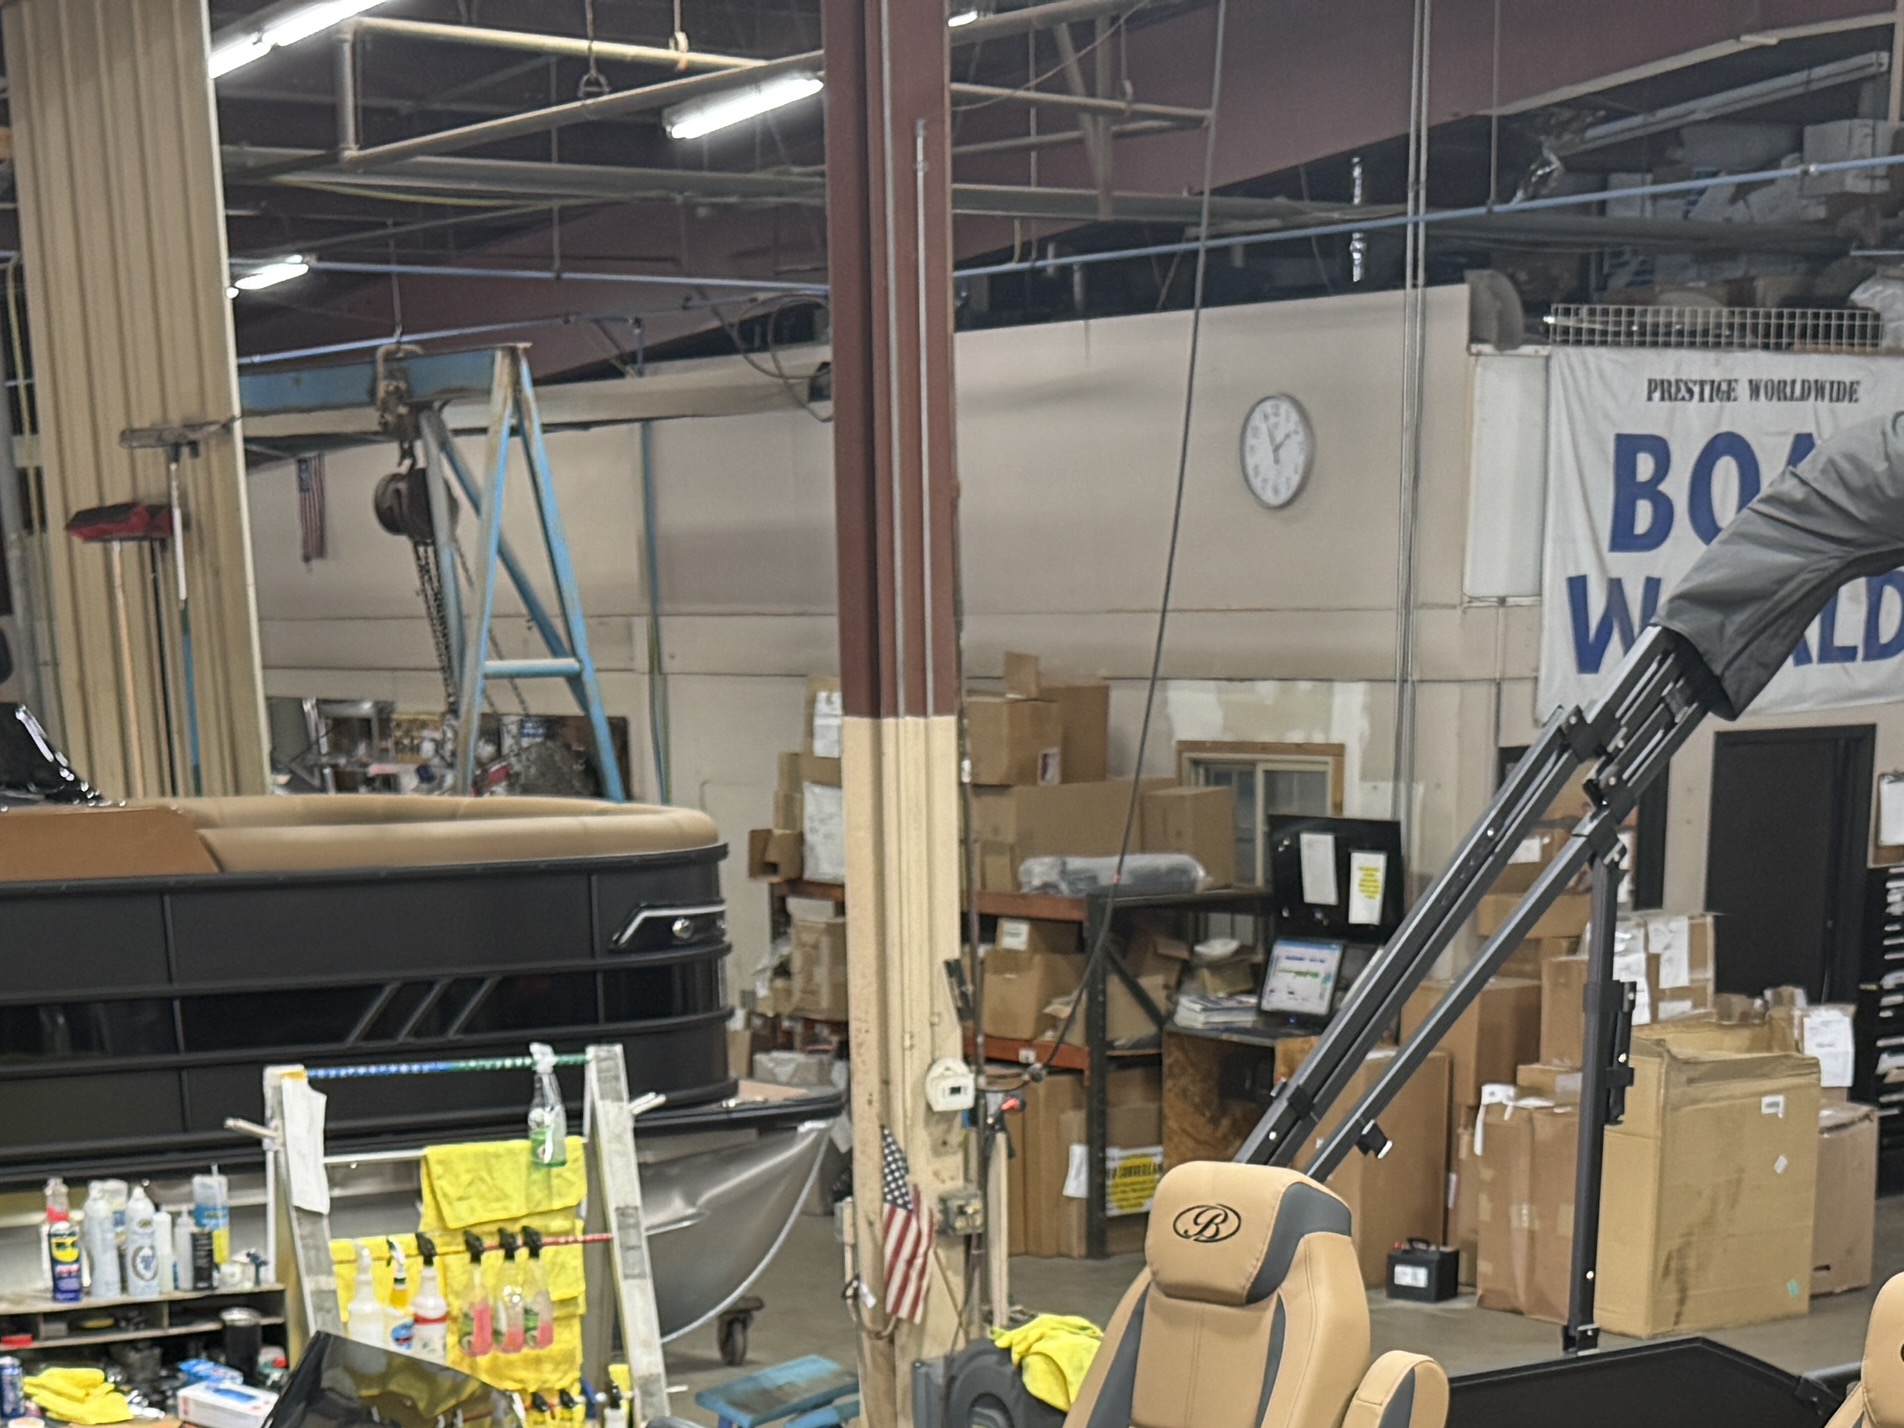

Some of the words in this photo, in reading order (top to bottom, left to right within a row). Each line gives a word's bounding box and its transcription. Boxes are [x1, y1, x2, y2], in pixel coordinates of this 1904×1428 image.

[1645, 377, 1739, 403] PRESTIGE
[1748, 378, 1861, 404] WORLDWIDE
[1607, 430, 1817, 554] BO
